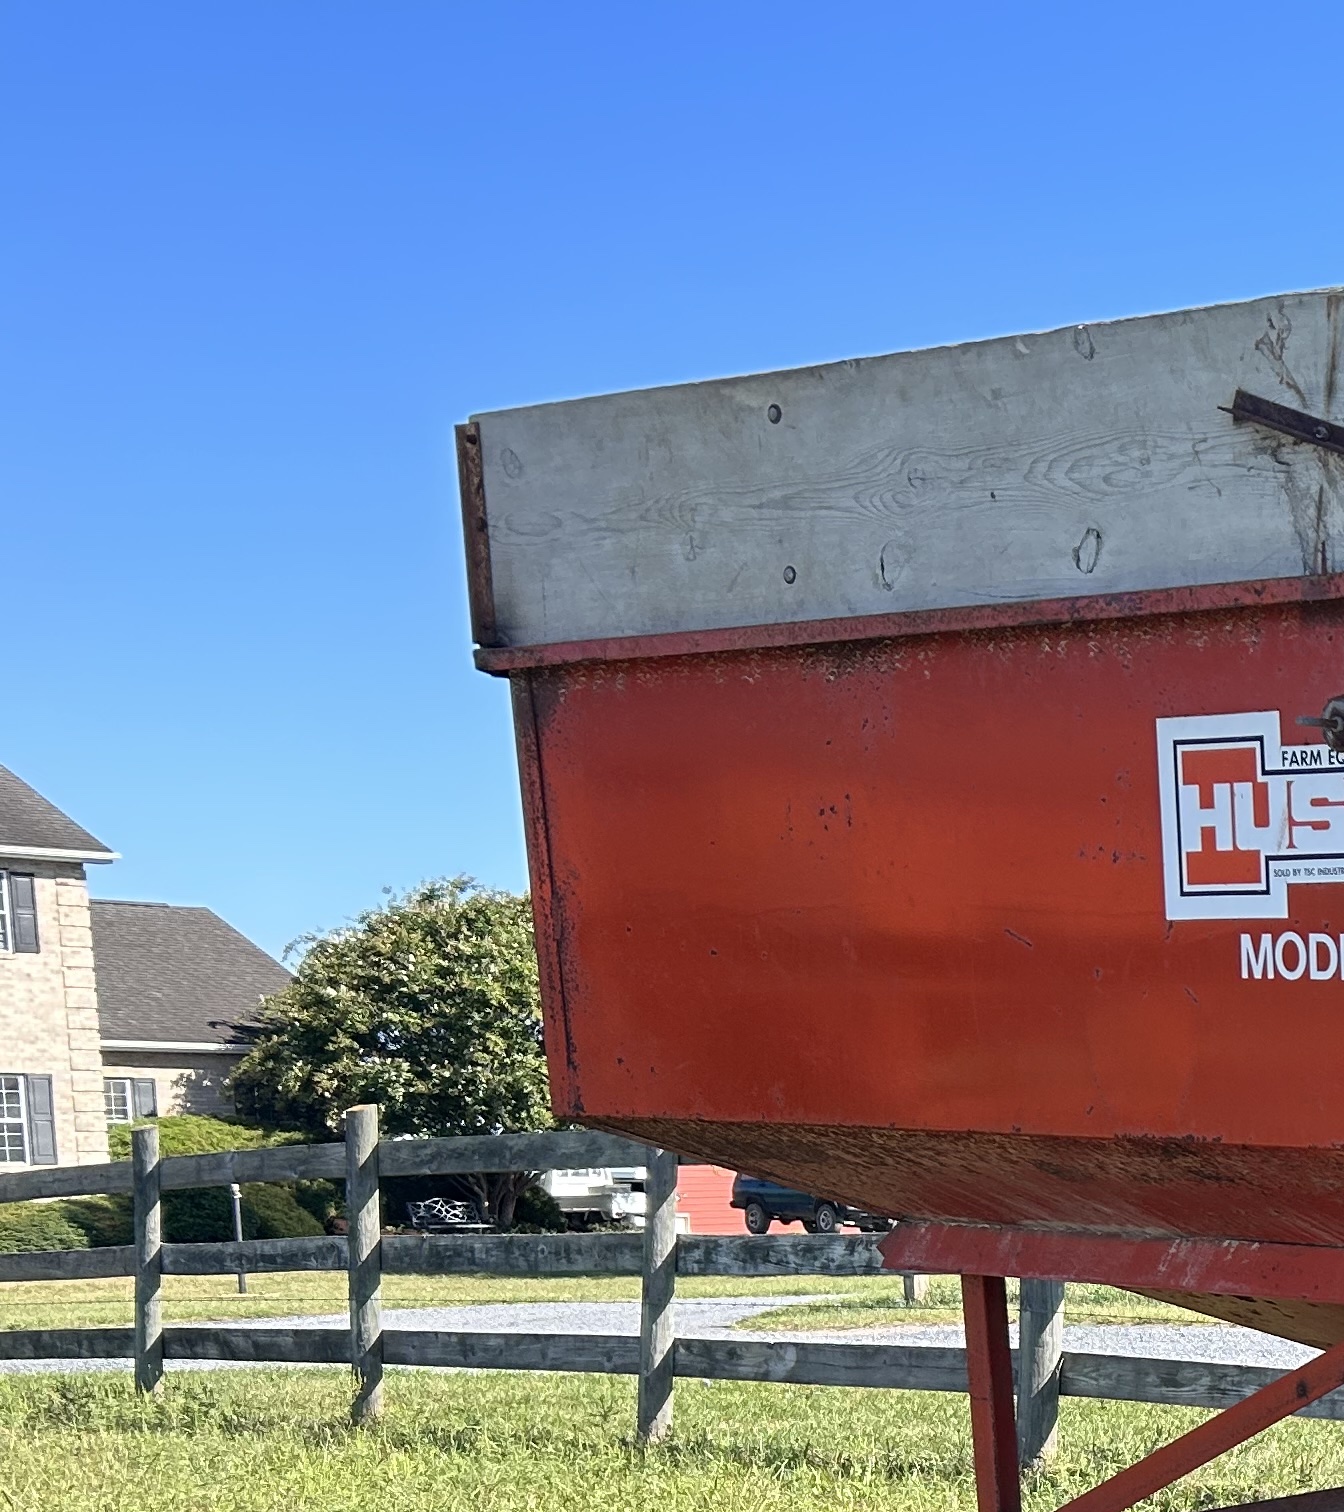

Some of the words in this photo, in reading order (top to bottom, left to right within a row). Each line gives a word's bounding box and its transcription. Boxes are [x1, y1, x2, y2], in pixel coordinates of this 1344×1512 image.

[1281, 749, 1323, 767] FARM
[1273, 868, 1291, 877] SOLD
[1292, 868, 1302, 876] BY
